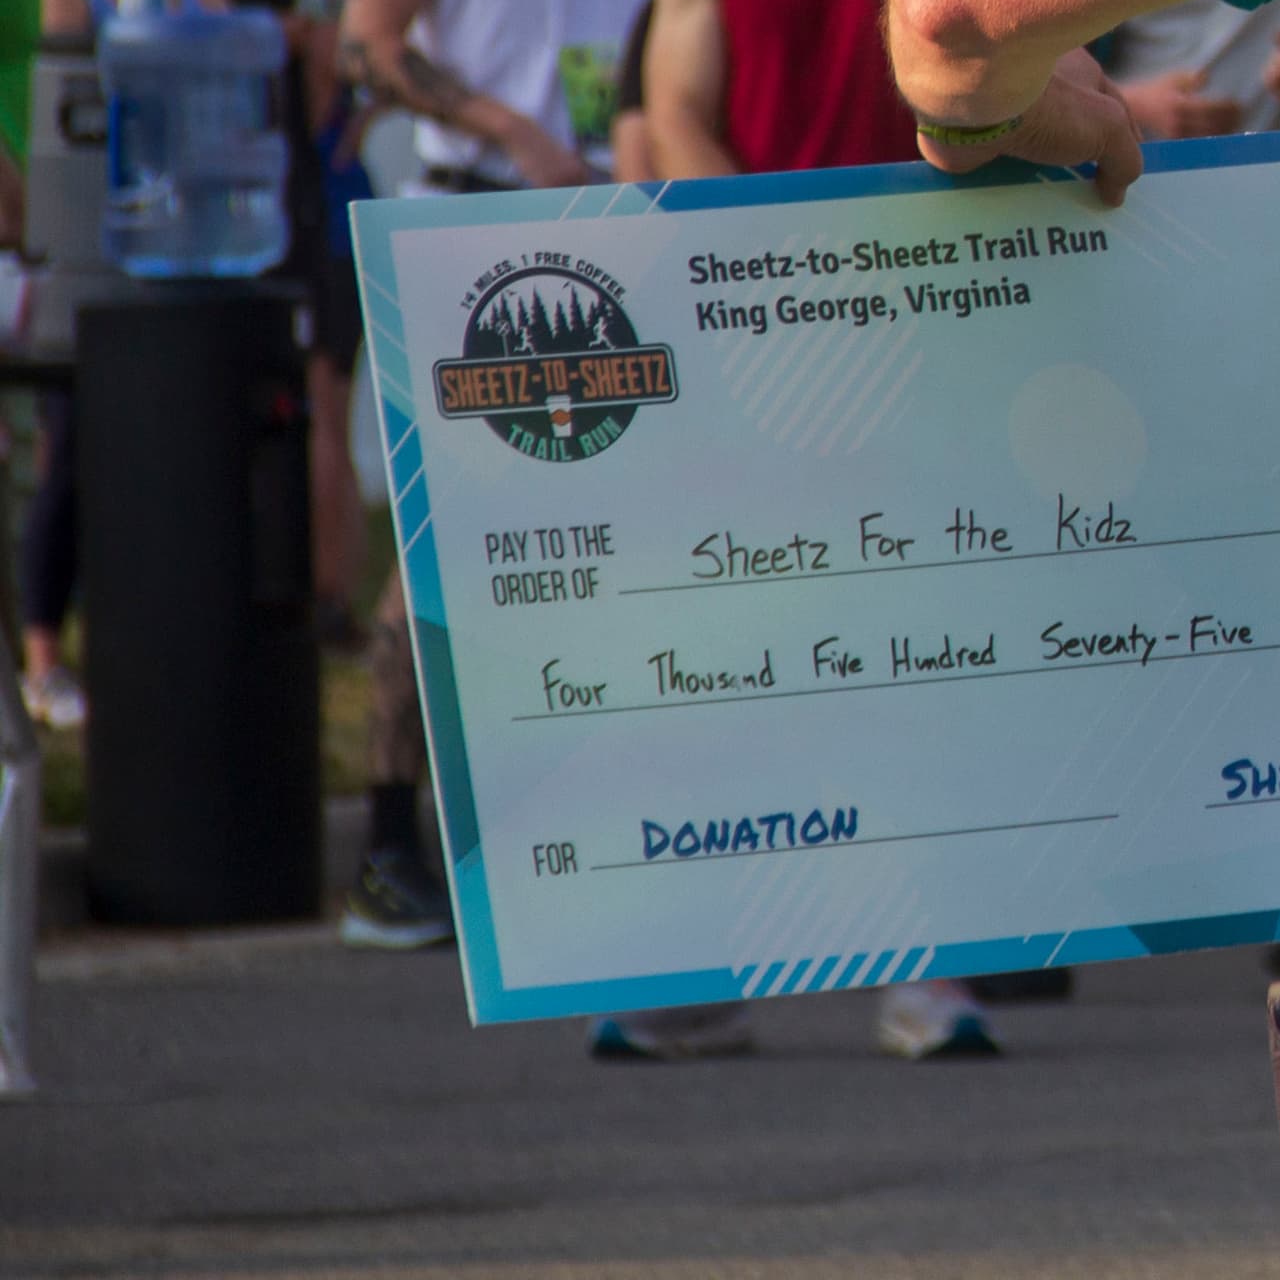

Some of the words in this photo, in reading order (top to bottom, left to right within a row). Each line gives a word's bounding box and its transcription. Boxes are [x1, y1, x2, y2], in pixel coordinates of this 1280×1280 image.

[534, 251, 572, 268] FREE
[689, 237, 959, 286] Sheetz-to-Sheetz
[964, 229, 1040, 264] Trail
[1047, 226, 1109, 255] Run
[696, 296, 768, 334] King
[775, 288, 899, 326] George,
[904, 277, 1031, 319] Virginia
[442, 352, 671, 410] SHEETZ-TO-SHEETZ
[507, 423, 573, 462] TRAIL
[577, 416, 624, 457] RUN
[485, 530, 528, 566] PAY
[534, 527, 565, 561] TO
[569, 523, 615, 558] THE
[691, 531, 830, 579] Sheetz
[859, 512, 915, 561] For
[945, 506, 1014, 555] the
[1056, 493, 1138, 551] Kidz
[491, 570, 567, 608] ORDER
[572, 567, 600, 600] OF
[540, 658, 608, 712] Four
[812, 636, 864, 679] Five
[1039, 614, 1254, 667] Seventy-Five
[532, 842, 578, 878] FOR
[640, 805, 859, 861] DONATION
